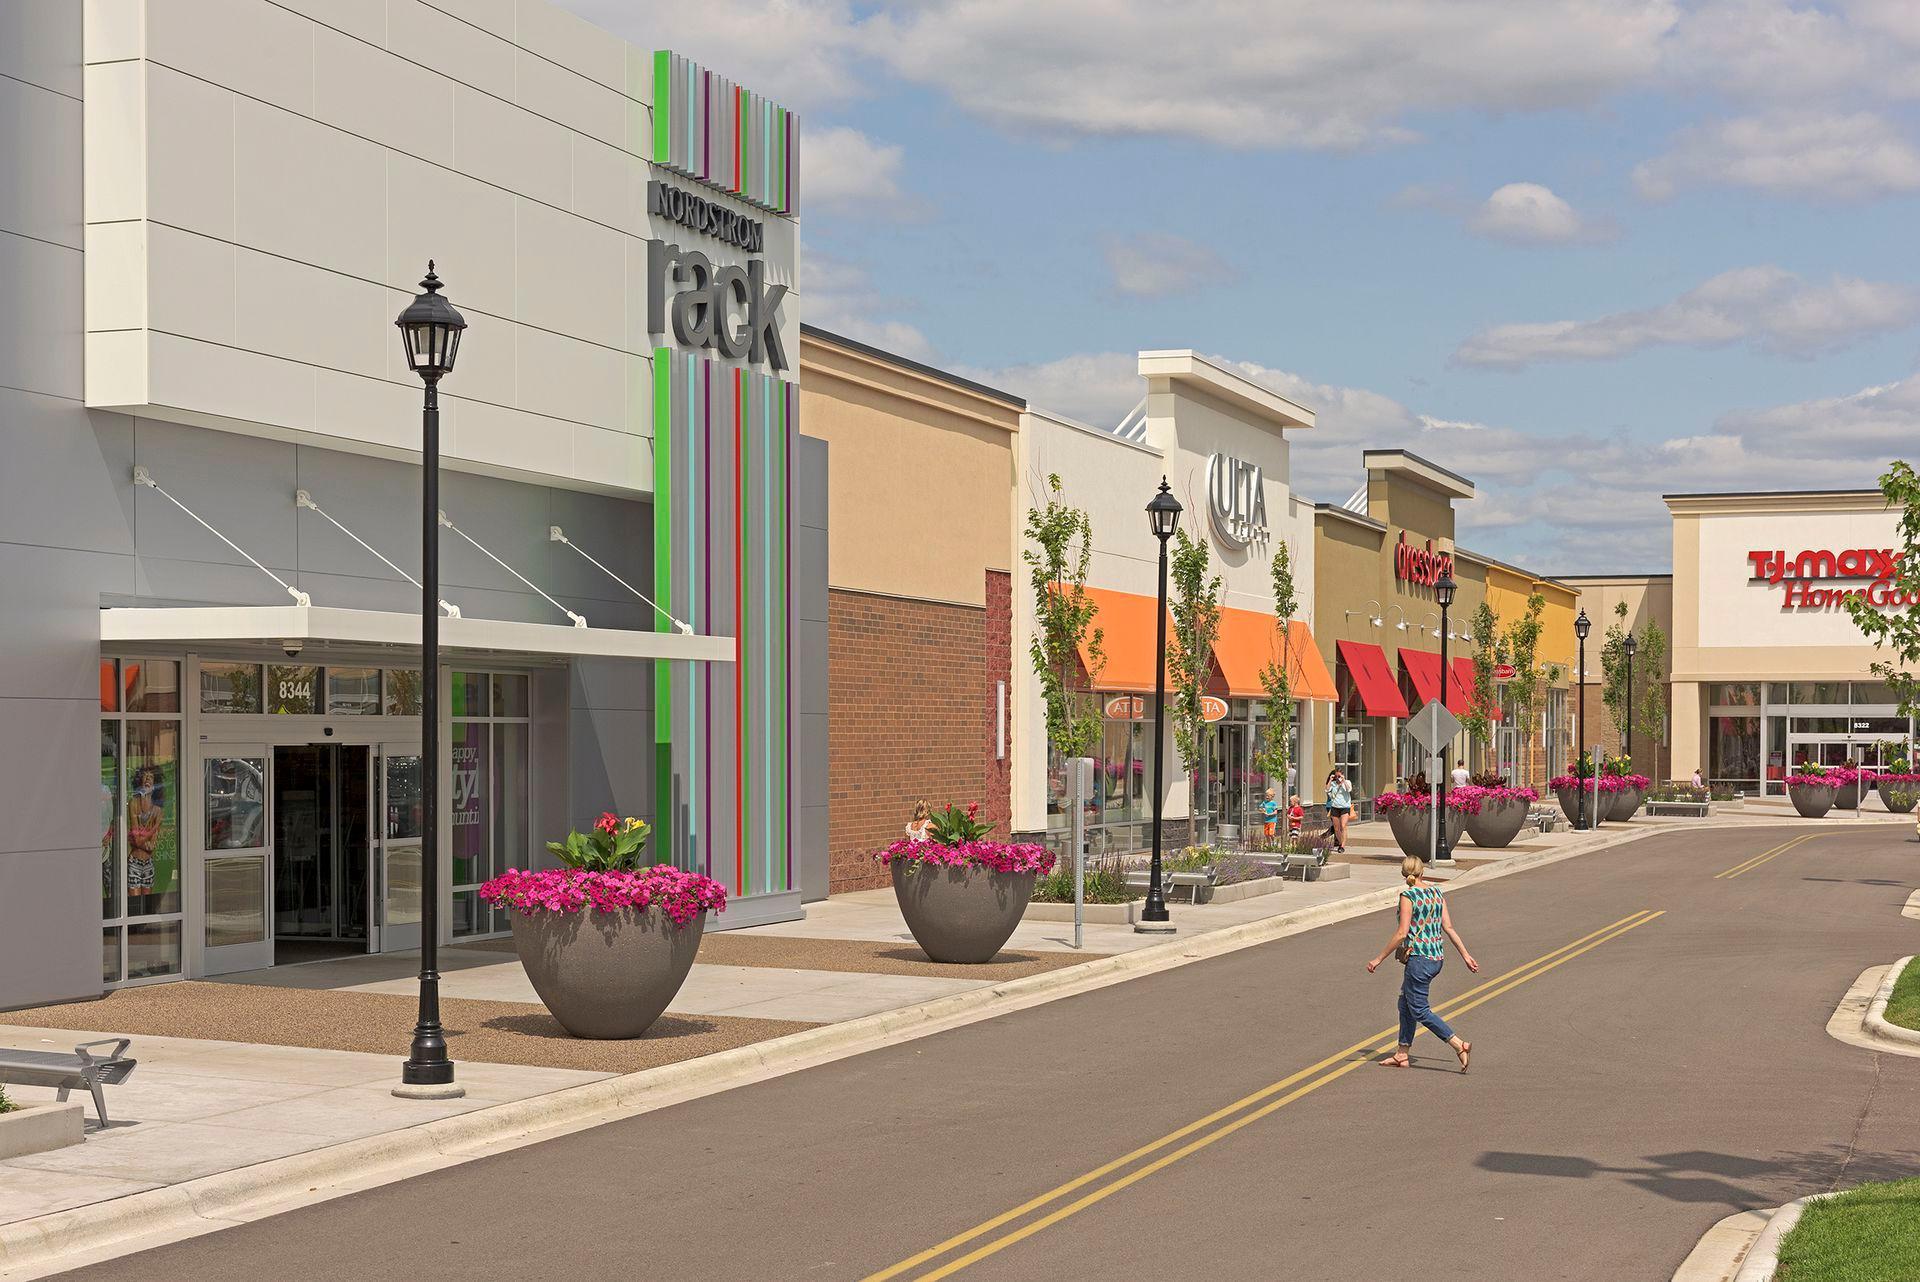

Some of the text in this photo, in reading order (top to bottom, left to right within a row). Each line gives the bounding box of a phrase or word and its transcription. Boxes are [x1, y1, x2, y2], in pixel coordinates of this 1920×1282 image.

[648, 180, 764, 253] NORDSTROM
[648, 239, 789, 371] rack
[1217, 453, 1267, 527] ULTA
[279, 681, 311, 699] 8344
